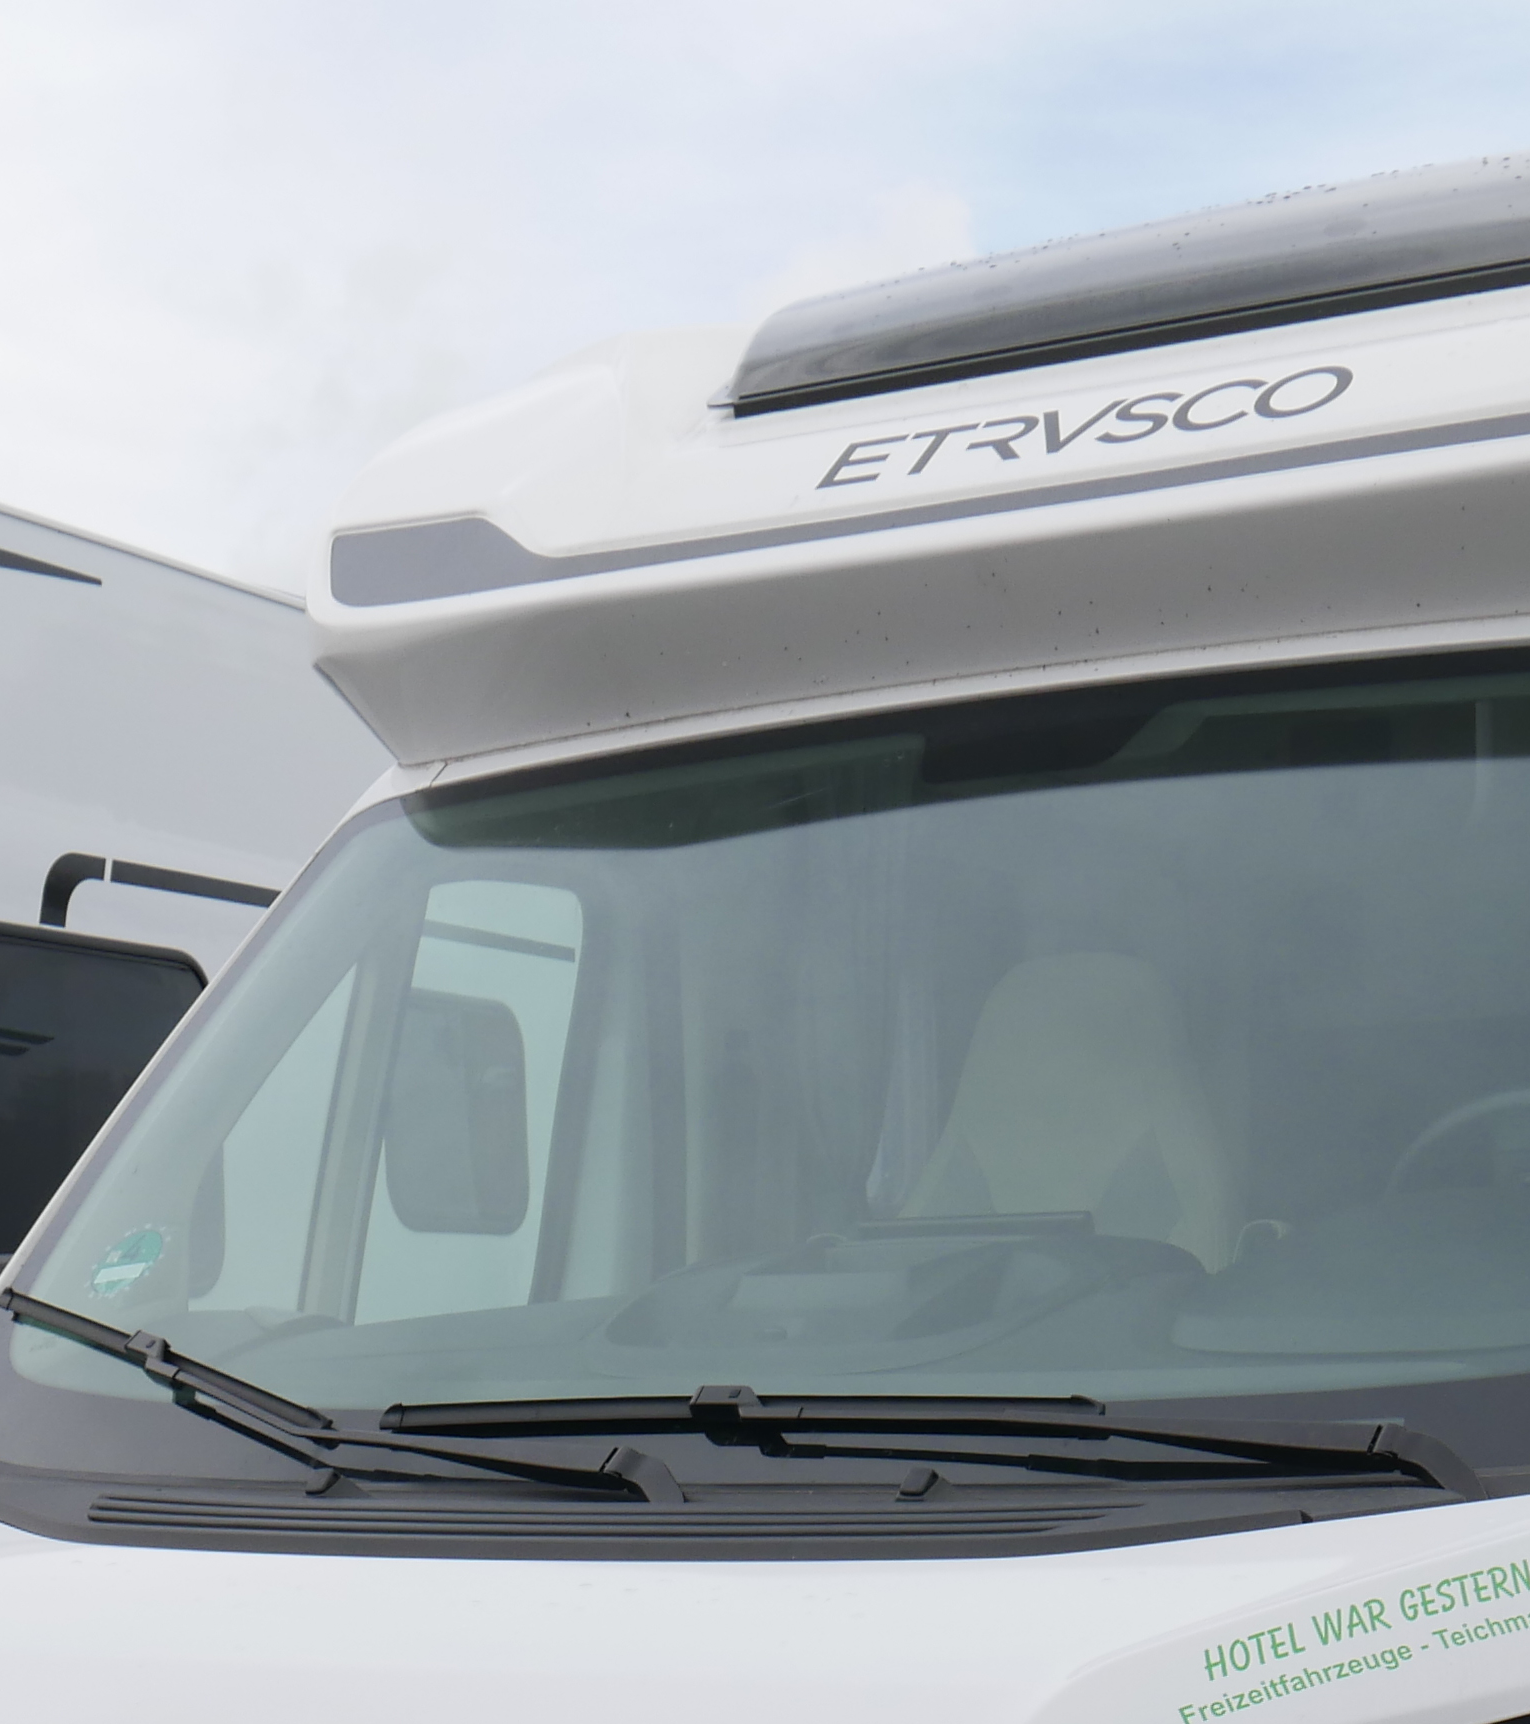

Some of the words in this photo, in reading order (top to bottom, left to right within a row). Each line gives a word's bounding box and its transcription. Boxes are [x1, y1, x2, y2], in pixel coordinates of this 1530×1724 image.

[815, 365, 1354, 490] ETRVSCO
[119, 1233, 147, 1261] 4
[1203, 1621, 1306, 1682] HOTEL
[1311, 1597, 1392, 1647] WAR
